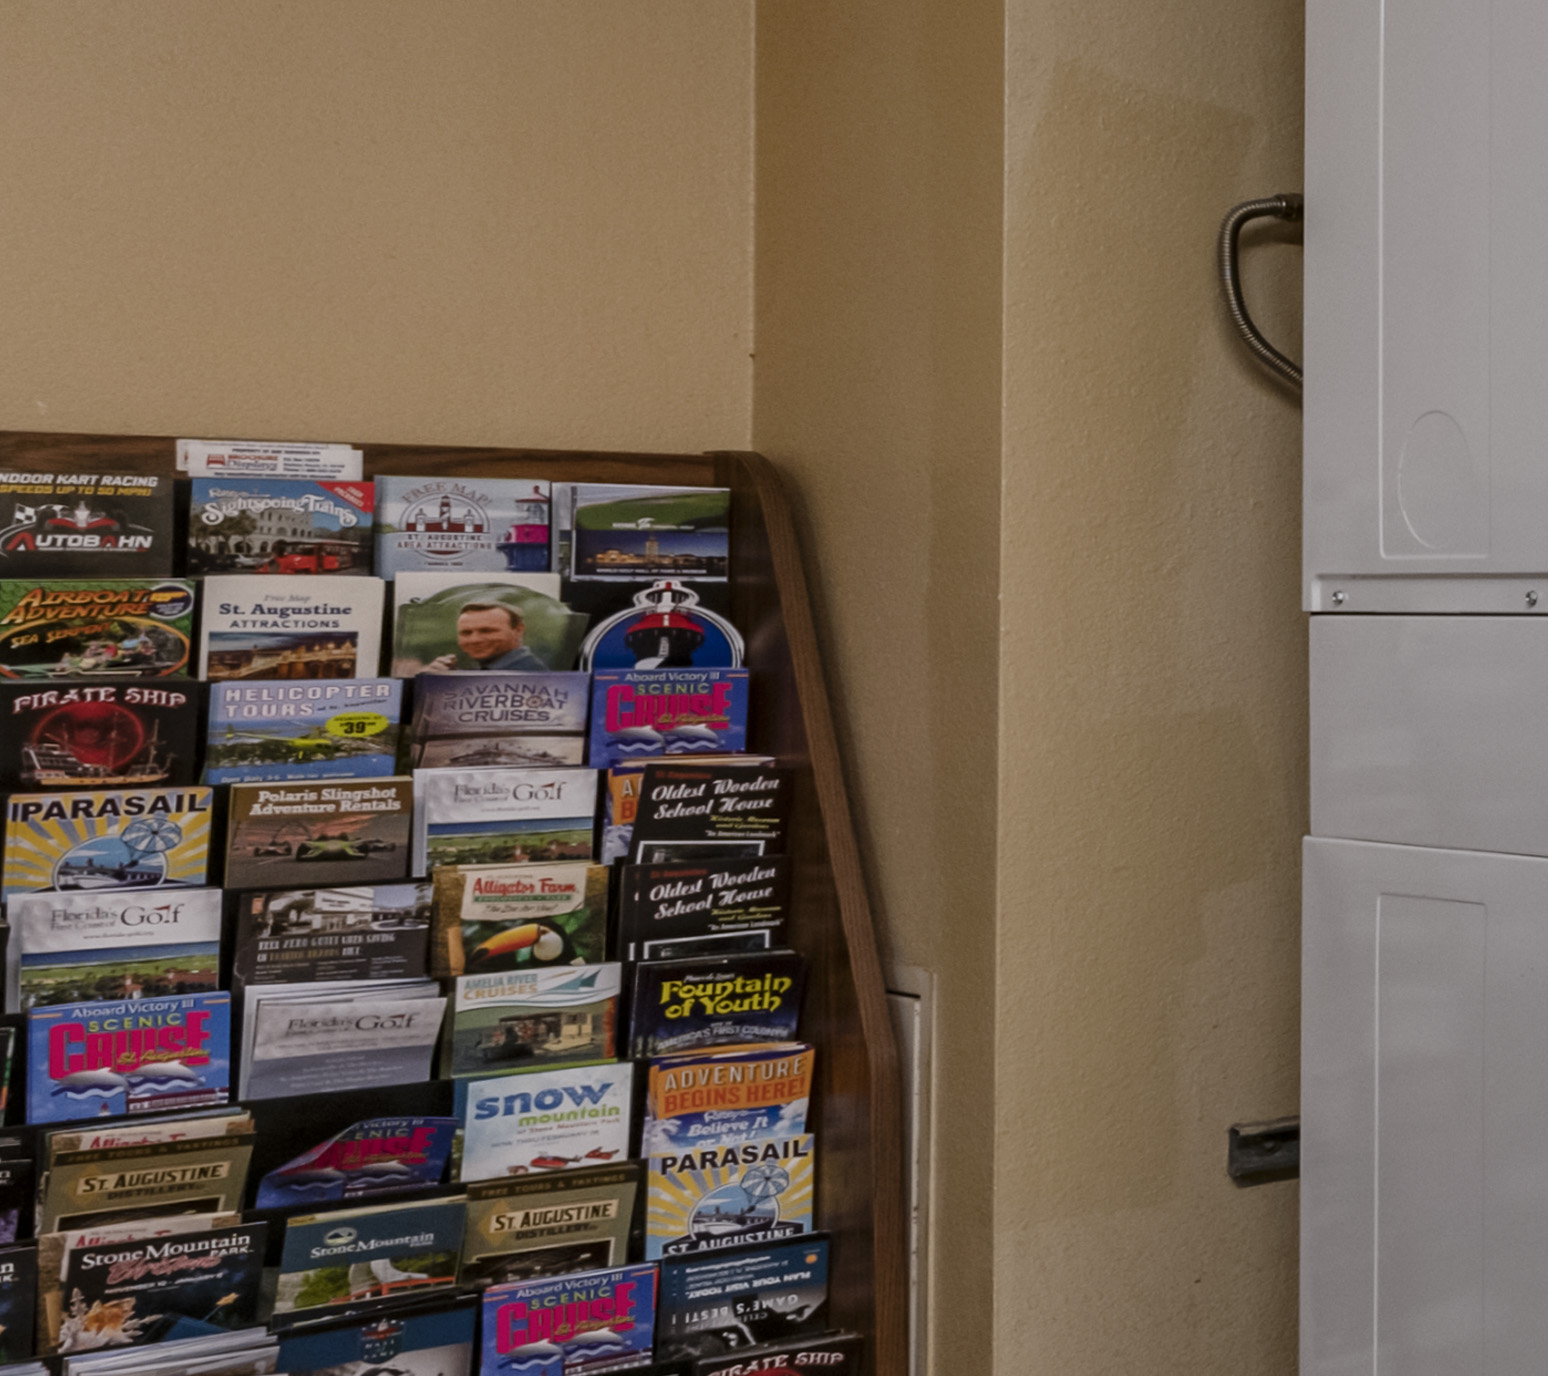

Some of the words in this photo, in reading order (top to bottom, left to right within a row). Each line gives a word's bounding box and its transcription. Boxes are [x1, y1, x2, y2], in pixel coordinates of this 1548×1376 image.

[56, 474, 99, 485] KART
[102, 476, 157, 487] RACING
[402, 482, 446, 505] FREE
[454, 482, 493, 505] MAP!
[6, 533, 152, 552] AUTOBAHN
[427, 542, 492, 550] ATTRACTIONS
[19, 589, 150, 605] AIRBOAT
[2, 603, 150, 622] ADVENTURE
[219, 603, 244, 615] St.
[252, 604, 352, 619] Augustine
[230, 620, 340, 629] ATTRACTIONS
[11, 634, 38, 647] SEA
[13, 688, 116, 713] PIRATE
[125, 688, 187, 706] SHIP
[225, 685, 391, 702] HELICOPTER
[443, 684, 569, 700] SAVANNAH
[225, 703, 313, 718] TOURS
[443, 696, 568, 710] RIVERBOAT
[458, 710, 550, 722] CRUISES
[258, 790, 318, 803] Polaris
[321, 787, 396, 802] Slingshot
[652, 784, 705, 801] Oldest
[713, 779, 780, 796] Wooden
[250, 802, 335, 816] Adventure
[340, 800, 401, 812] Rentals
[654, 800, 713, 819] School
[718, 797, 774, 814] House
[473, 878, 535, 896] Alligator
[538, 878, 576, 894] Farm
[464, 976, 504, 990] AMELIA
[507, 974, 537, 985] RIVER
[659, 973, 793, 1005] Fountain
[463, 983, 537, 1001] CRUISES
[72, 1002, 125, 1018] Aboard
[128, 1000, 178, 1014] Victory
[664, 1000, 694, 1019] of
[701, 993, 782, 1016] Youth
[89, 1012, 182, 1032] SCENIC
[49, 1010, 212, 1081] CRUISE
[665, 1056, 807, 1091] ADVENTURE
[475, 1083, 614, 1120] snow
[664, 1086, 740, 1114] BEGINS
[747, 1077, 806, 1103] HERE!
[518, 1105, 620, 1127] mountain
[520, 1203, 613, 1228] AUGUSTINE
